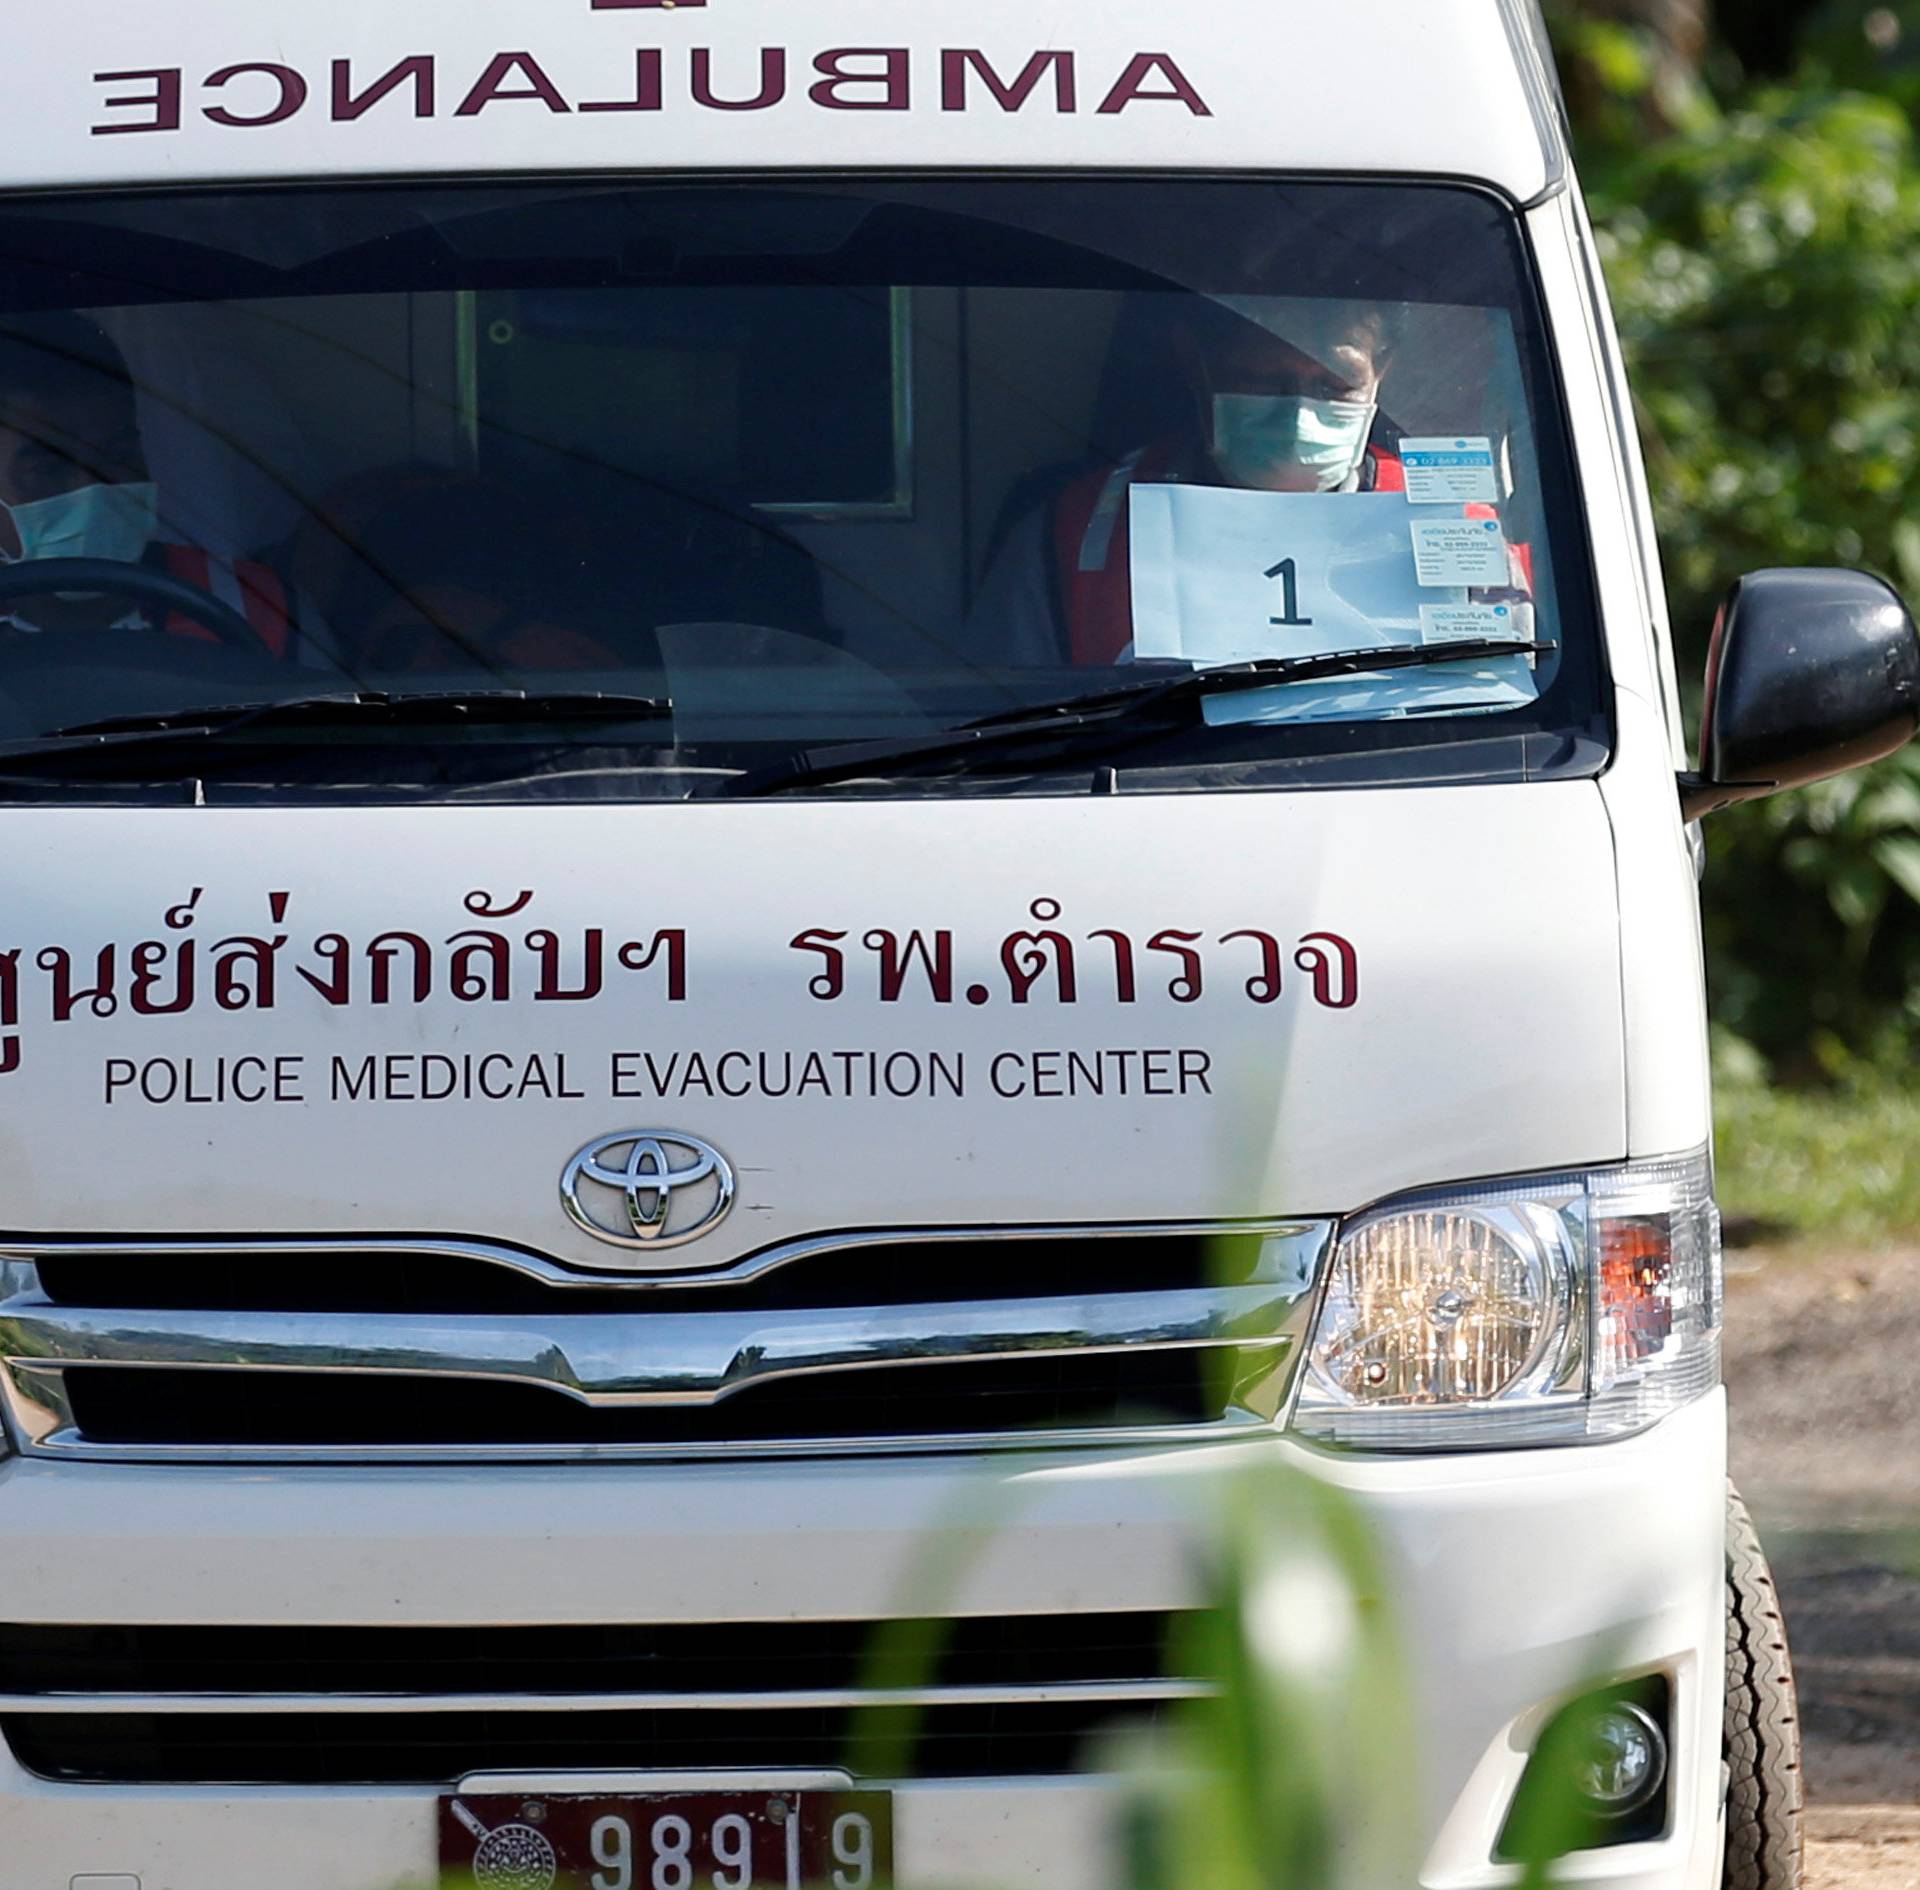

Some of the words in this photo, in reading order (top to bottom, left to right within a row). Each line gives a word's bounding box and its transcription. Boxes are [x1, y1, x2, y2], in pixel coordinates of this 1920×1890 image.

[1263, 557, 1313, 626] 1
[789, 897, 1358, 1009] รพ.ตำรวจ
[106, 1057, 304, 1104] POLICE
[332, 1053, 585, 1101] MEDICAL
[612, 1051, 964, 1098] EVACUATION
[990, 1050, 1212, 1098] CENTER
